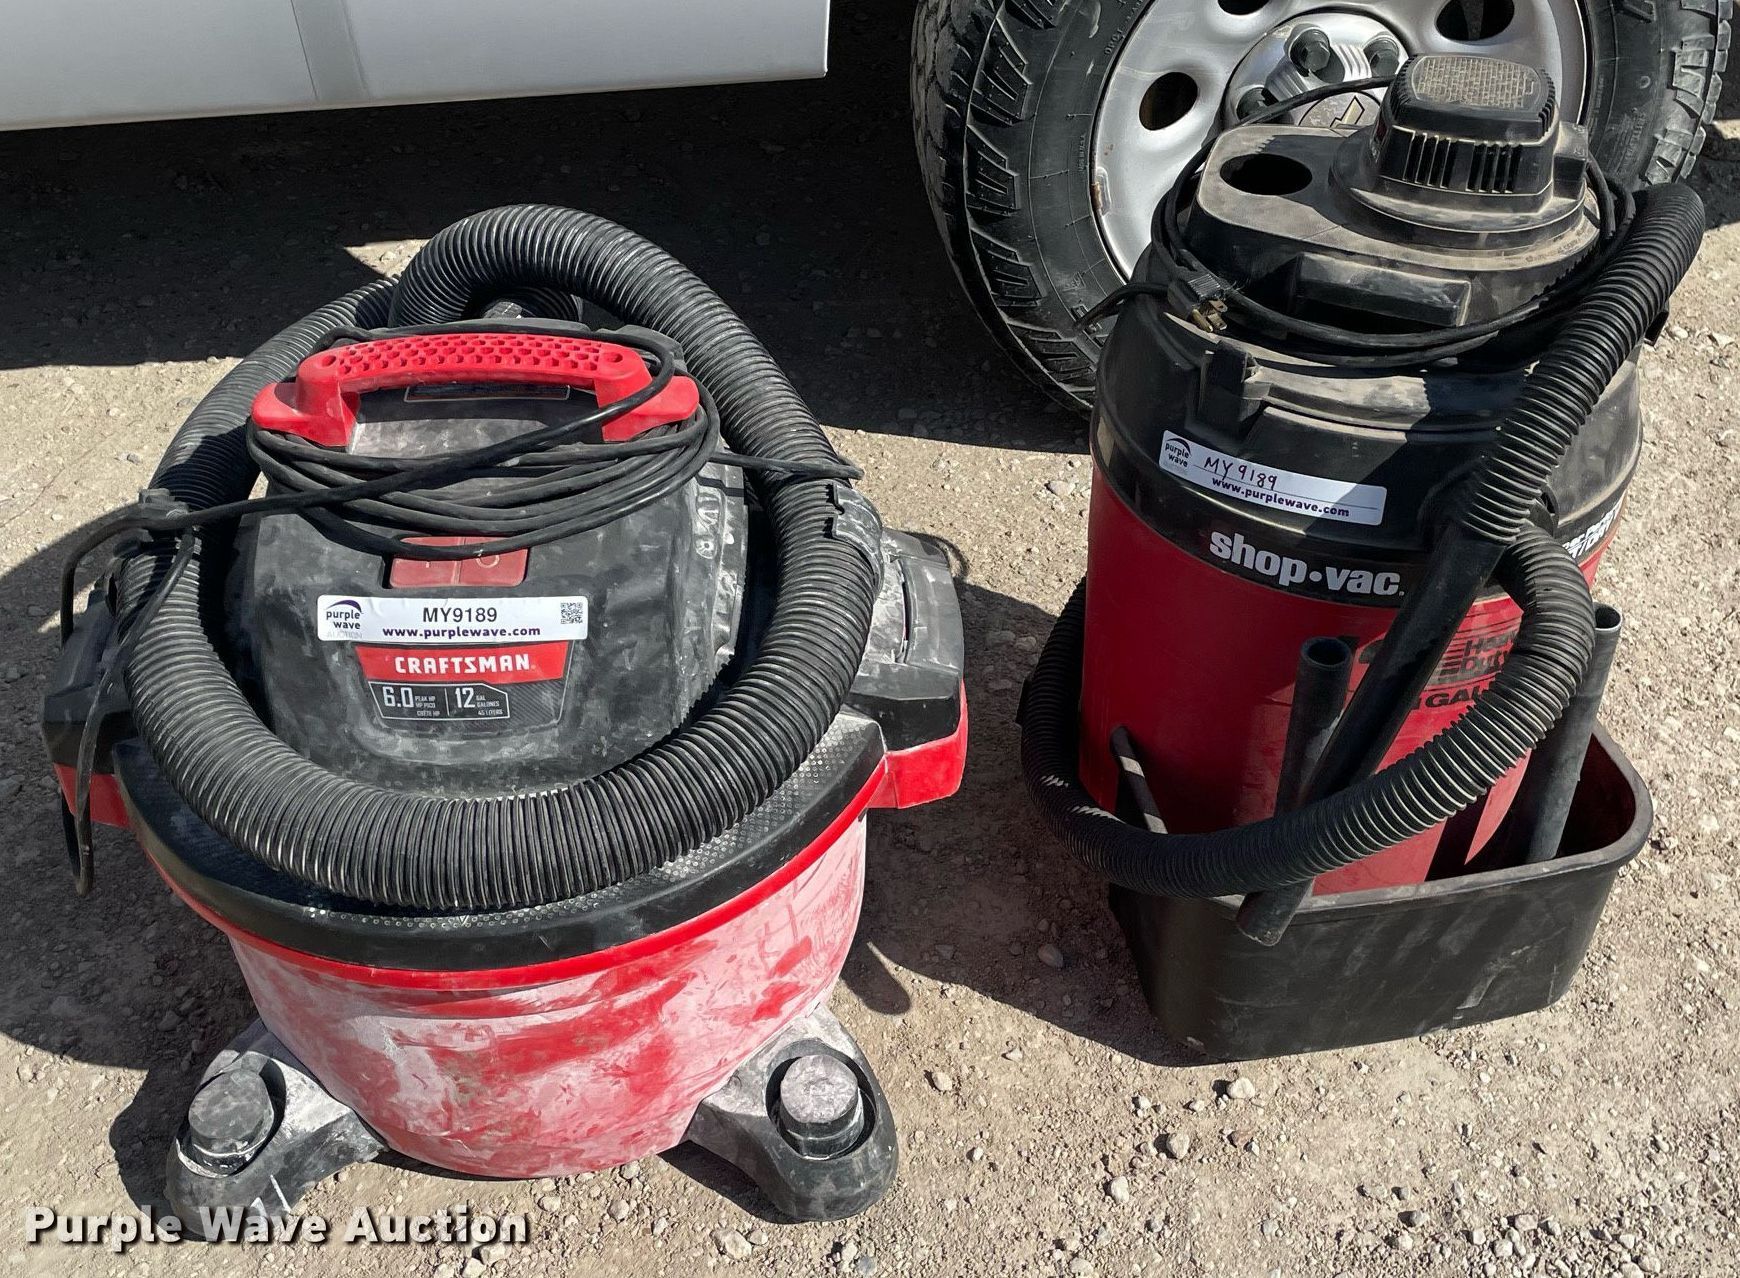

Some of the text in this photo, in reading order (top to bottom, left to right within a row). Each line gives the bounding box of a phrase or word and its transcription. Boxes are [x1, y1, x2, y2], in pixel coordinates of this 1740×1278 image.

[1165, 443, 1190, 458] purple
[1169, 454, 1188, 467] wave
[1212, 477, 1350, 517] www.purplewave.com
[326, 609, 361, 621] purple
[423, 607, 497, 623] MY9189
[333, 621, 361, 630] wave
[382, 626, 541, 639] www.purplewave.com
[395, 653, 530, 674] CRAFTSMAN
[382, 686, 414, 708] 6.0
[455, 687, 475, 708] 12
